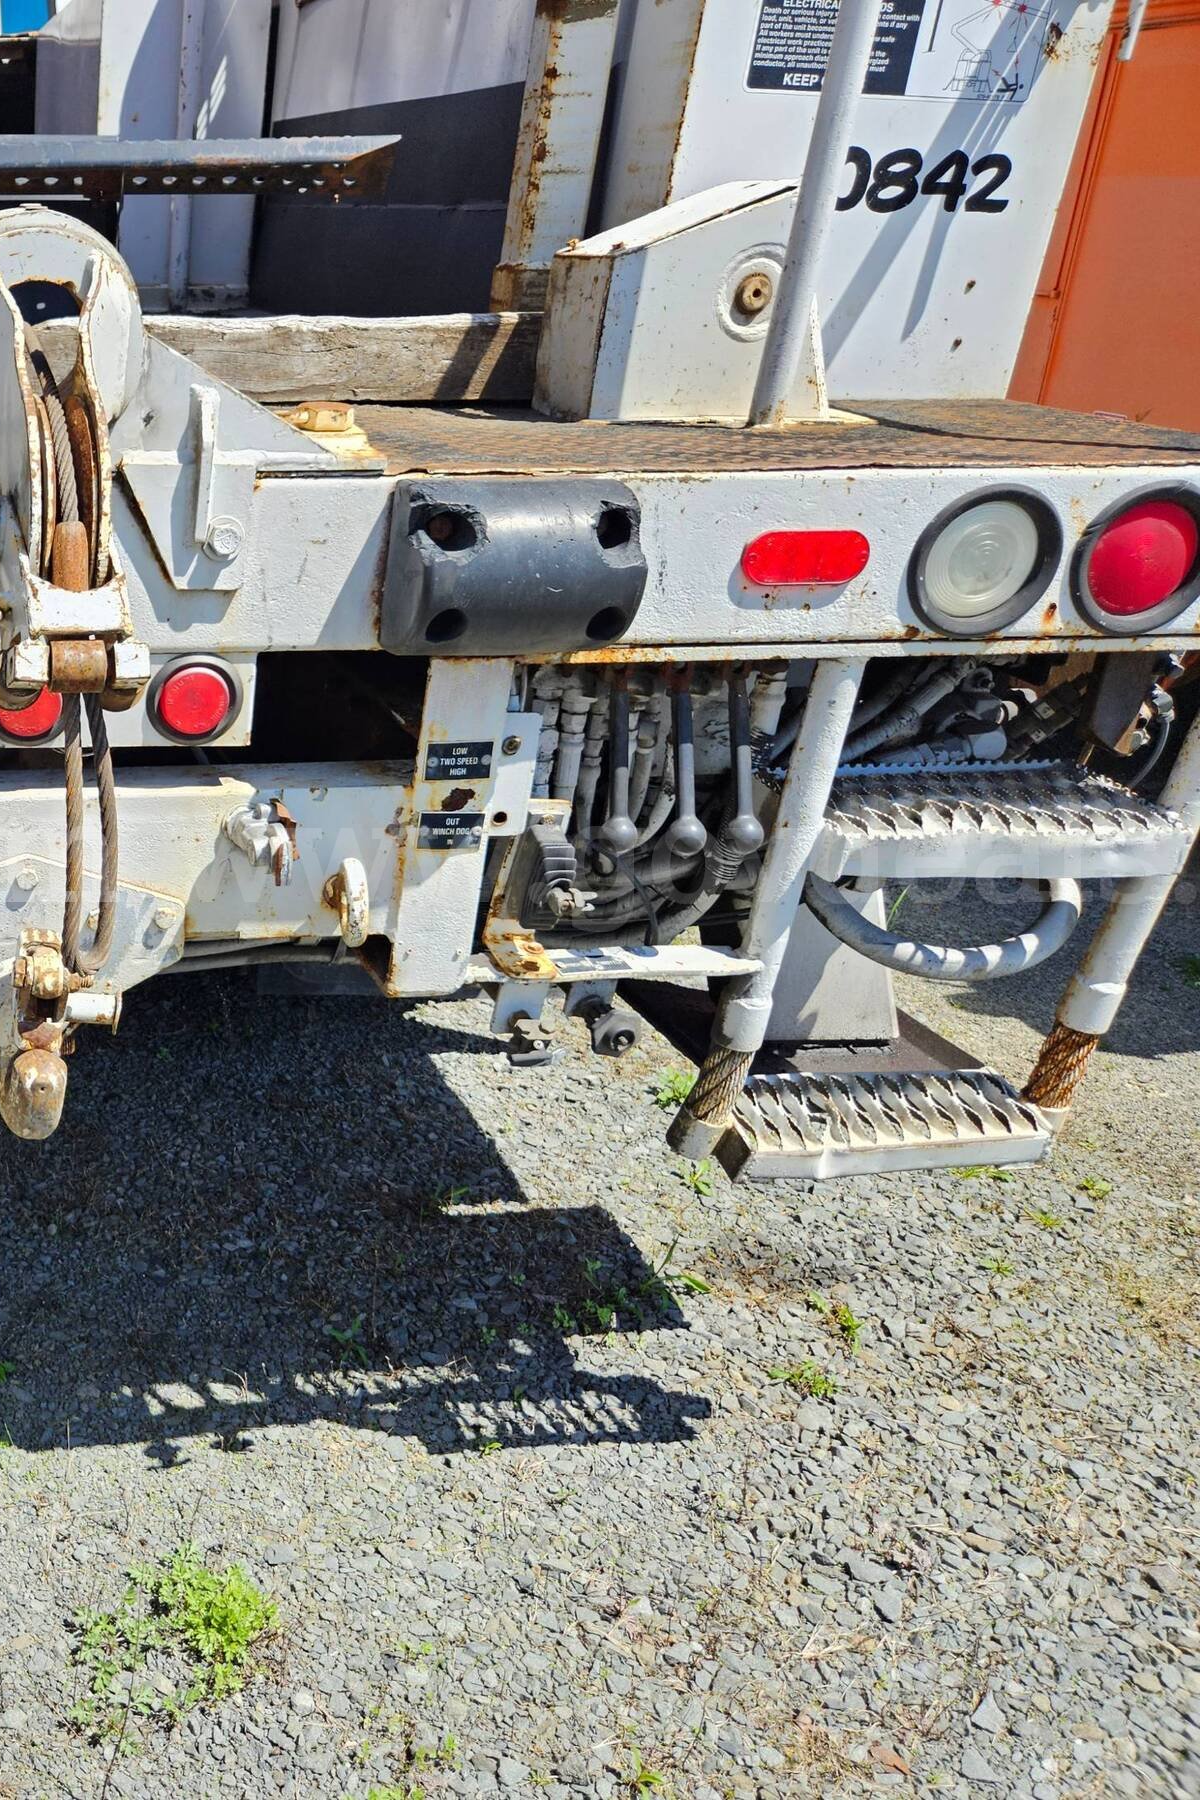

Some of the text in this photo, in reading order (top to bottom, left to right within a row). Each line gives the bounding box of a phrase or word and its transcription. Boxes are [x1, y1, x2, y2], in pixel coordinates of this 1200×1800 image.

[763, 6, 782, 14] Death
[791, 8, 814, 16] serious
[816, 9, 834, 18] injury
[760, 22, 773, 30] part
[896, 22, 908, 30] any
[784, 53, 813, 62] approach
[753, 59, 786, 68] conductor,
[796, 61, 828, 69] unauthori
[783, 73, 820, 86] KEEP
[452, 747, 469, 756] LOW
[440, 756, 479, 766] TWO SPEED
[449, 767, 467, 776] HIGH
[445, 817, 460, 826] OUT
[432, 827, 470, 835] WINCH DOG
